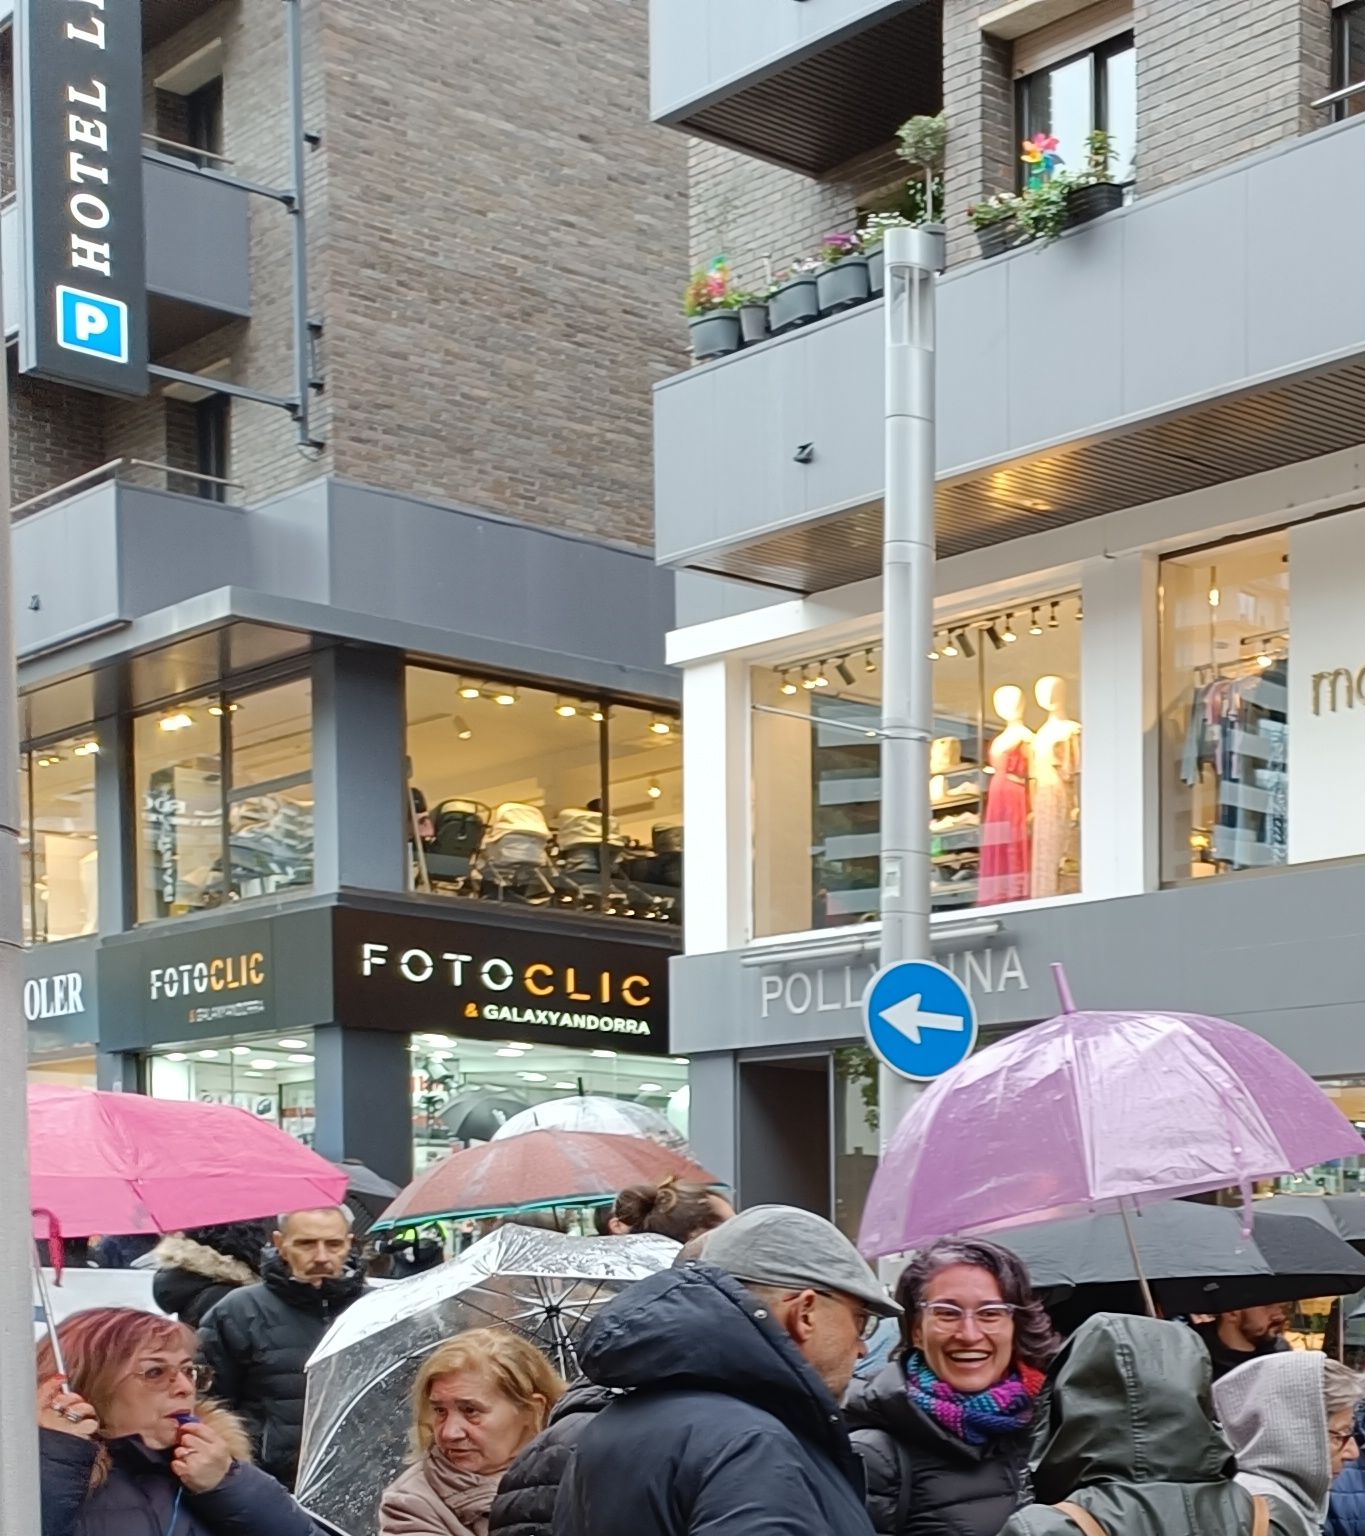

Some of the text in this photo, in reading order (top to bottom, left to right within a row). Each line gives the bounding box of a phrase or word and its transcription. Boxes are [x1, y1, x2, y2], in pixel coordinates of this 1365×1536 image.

[69, 79, 112, 277] HOTEL
[75, 302, 109, 341] P
[150, 952, 265, 1000] FOTOCLIC
[363, 943, 651, 1006] FOTOCLIC
[464, 1002, 651, 1036] & GALAXYANDORRA
